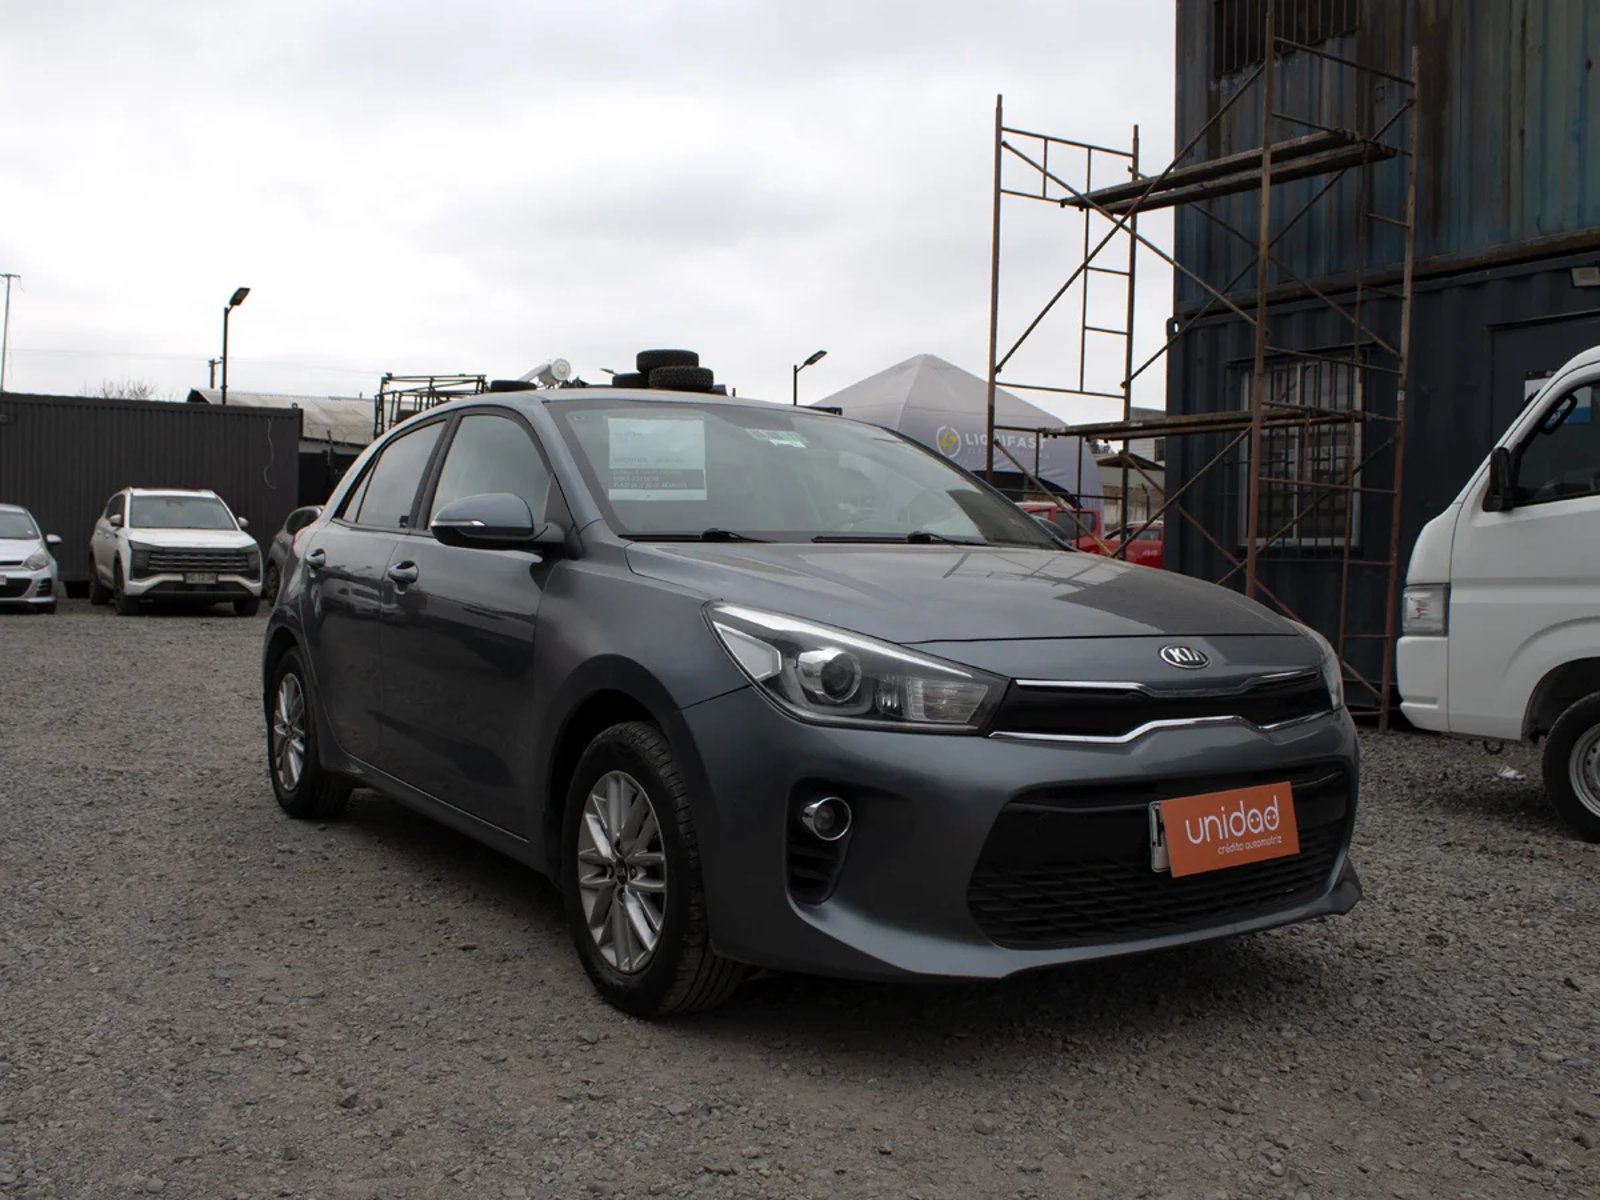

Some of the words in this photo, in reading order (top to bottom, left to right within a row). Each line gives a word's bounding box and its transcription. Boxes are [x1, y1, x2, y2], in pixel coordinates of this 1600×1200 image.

[1166, 647, 1207, 664] KIA
[1185, 795, 1280, 844] unidad
[1245, 835, 1282, 850] automotriz
